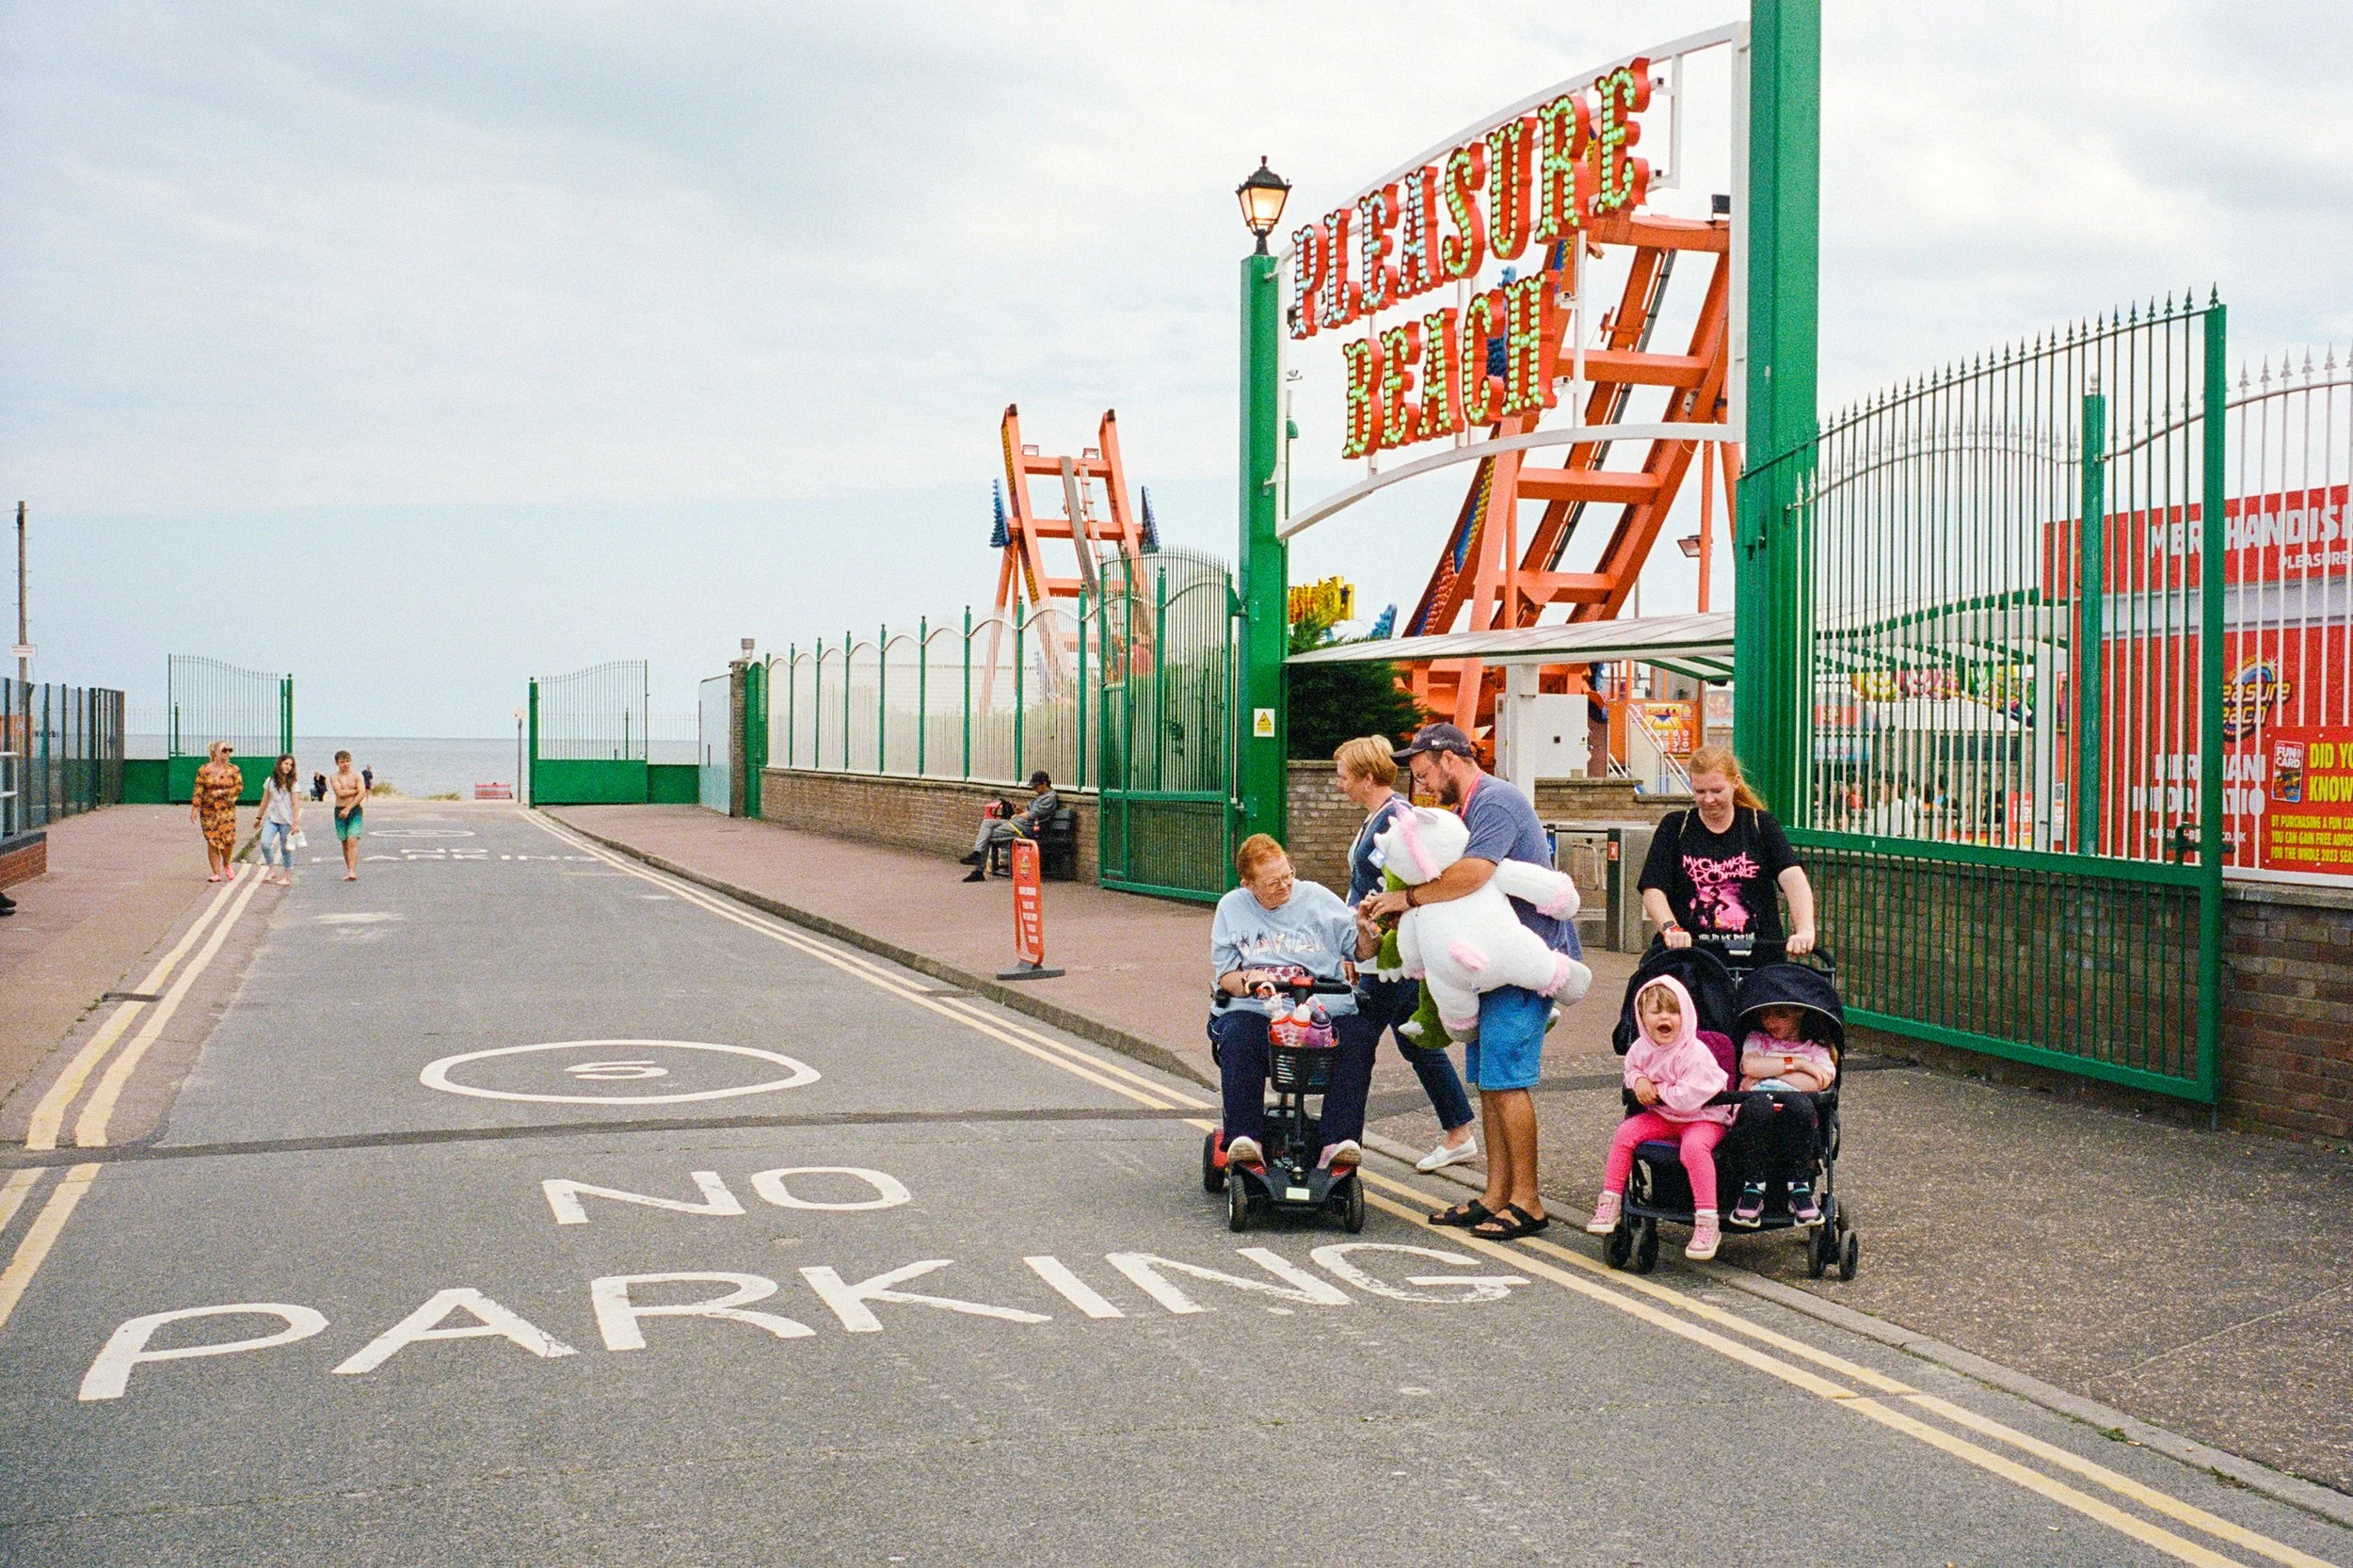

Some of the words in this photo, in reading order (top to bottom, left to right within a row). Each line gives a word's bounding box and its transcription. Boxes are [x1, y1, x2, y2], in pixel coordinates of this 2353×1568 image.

[1289, 58, 1650, 340] PLEASURE
[1342, 270, 1559, 459] BEACH
[2152, 504, 2353, 558] MERHANDIS
[2310, 743, 2334, 769] DID
[566, 1060, 670, 1080] 5
[541, 1166, 911, 1225] NO
[78, 1241, 1532, 1400] PARKING
